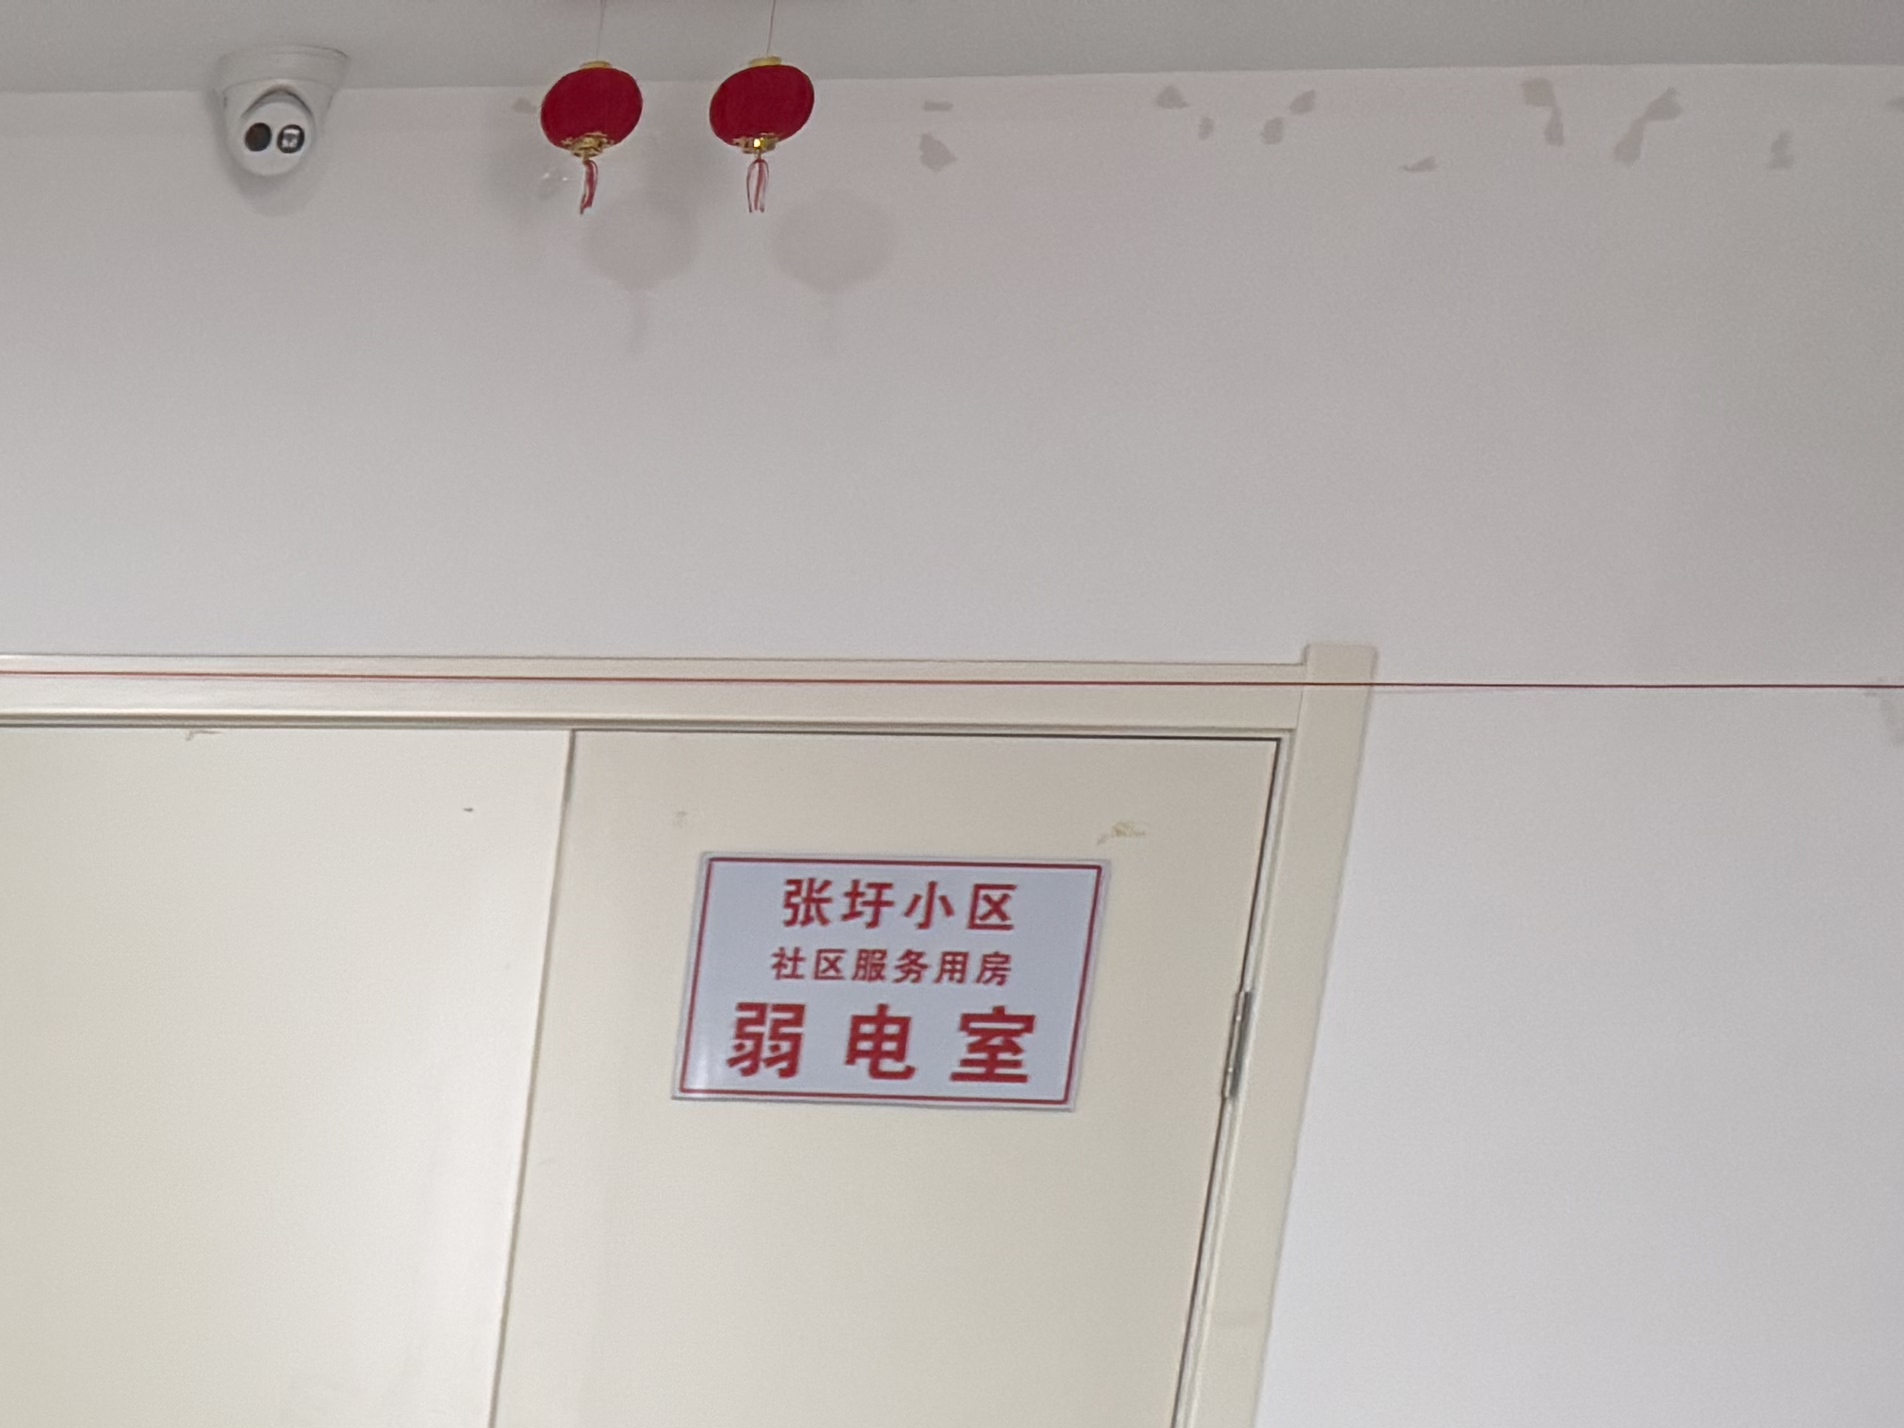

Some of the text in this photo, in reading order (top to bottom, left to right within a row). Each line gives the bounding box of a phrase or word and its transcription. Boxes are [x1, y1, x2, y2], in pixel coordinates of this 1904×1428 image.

[782, 877, 1018, 931] 张圩小区
[771, 946, 1013, 986] 社区服务用房
[726, 1002, 1036, 1084] 弱电室
